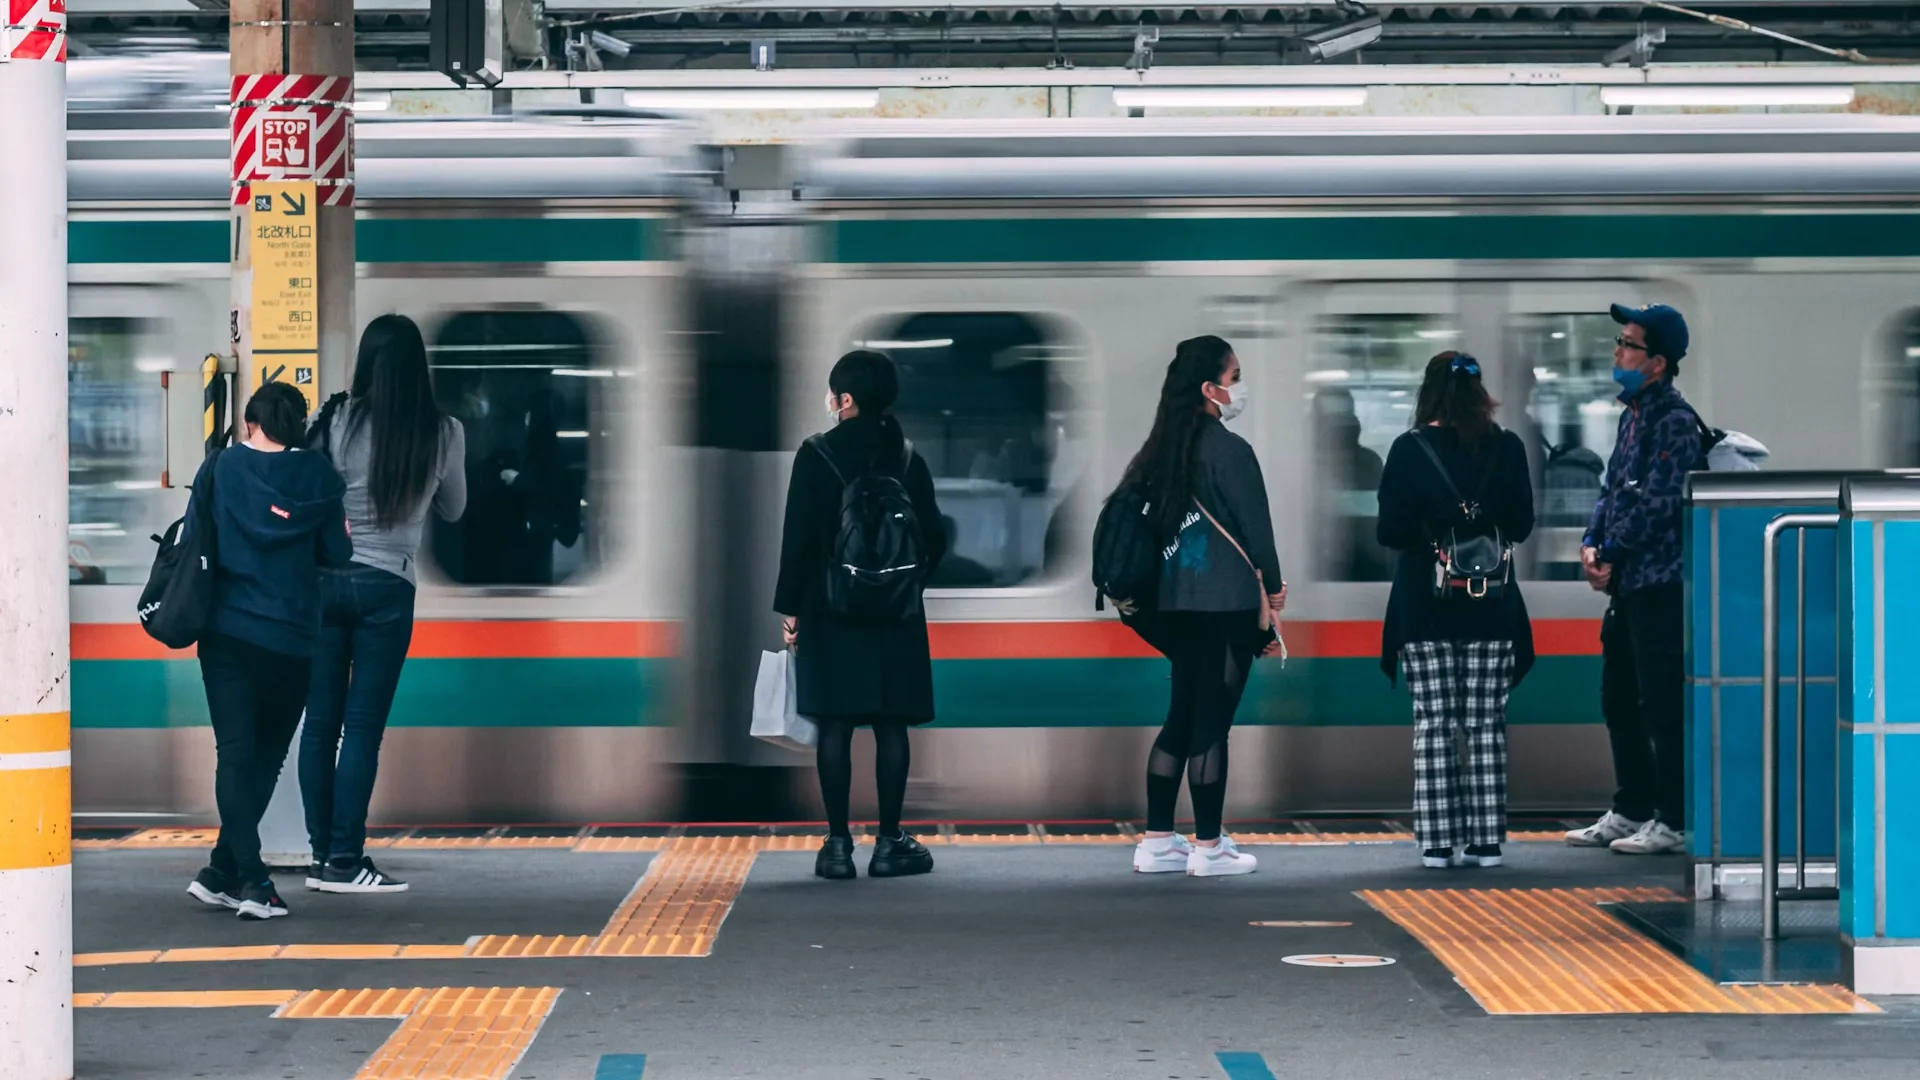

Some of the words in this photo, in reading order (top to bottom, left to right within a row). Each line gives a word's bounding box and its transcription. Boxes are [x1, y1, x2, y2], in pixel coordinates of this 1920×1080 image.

[264, 121, 307, 135] STOP
[256, 225, 312, 239] 北改札口
[267, 241, 290, 249] North
[288, 277, 312, 289] 東口
[288, 310, 312, 322] 西口
